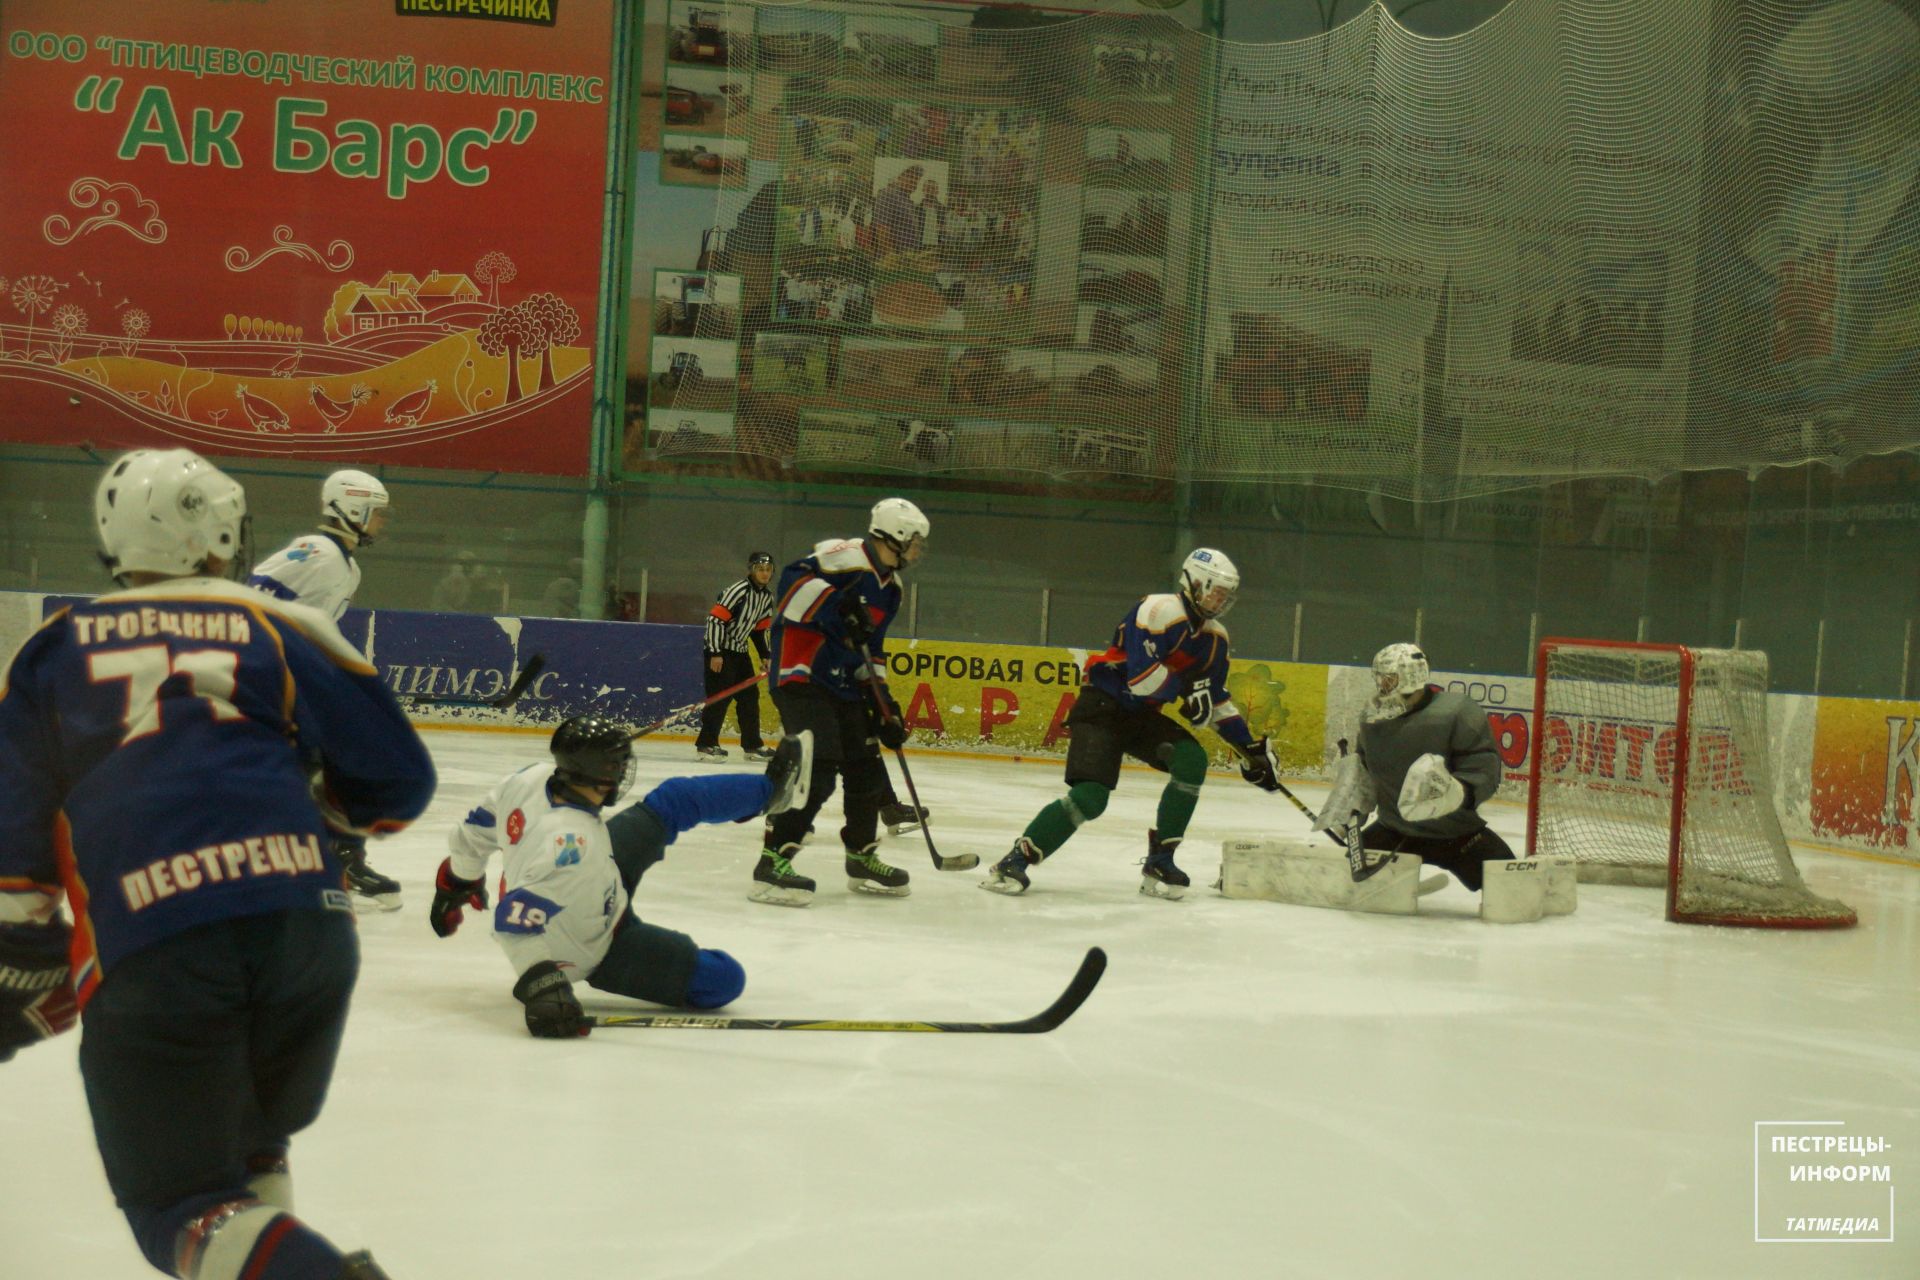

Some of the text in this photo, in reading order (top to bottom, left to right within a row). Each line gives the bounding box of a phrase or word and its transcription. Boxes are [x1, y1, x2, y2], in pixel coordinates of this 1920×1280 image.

[9, 30, 87, 62] ООО
[425, 64, 604, 104] КОМПЛЕКС
[74, 606, 251, 644] ТРОЕЦКИЙ
[383, 664, 560, 700] ЛИМЭС
[1034, 661, 1081, 687] СЕТ
[88, 644, 249, 747] 77
[121, 834, 325, 912] ПЕСТРЕЦЫ
[1505, 862, 1538, 872] CCM
[506, 900, 547, 928] 19
[650, 1015, 732, 1029] BAUER
